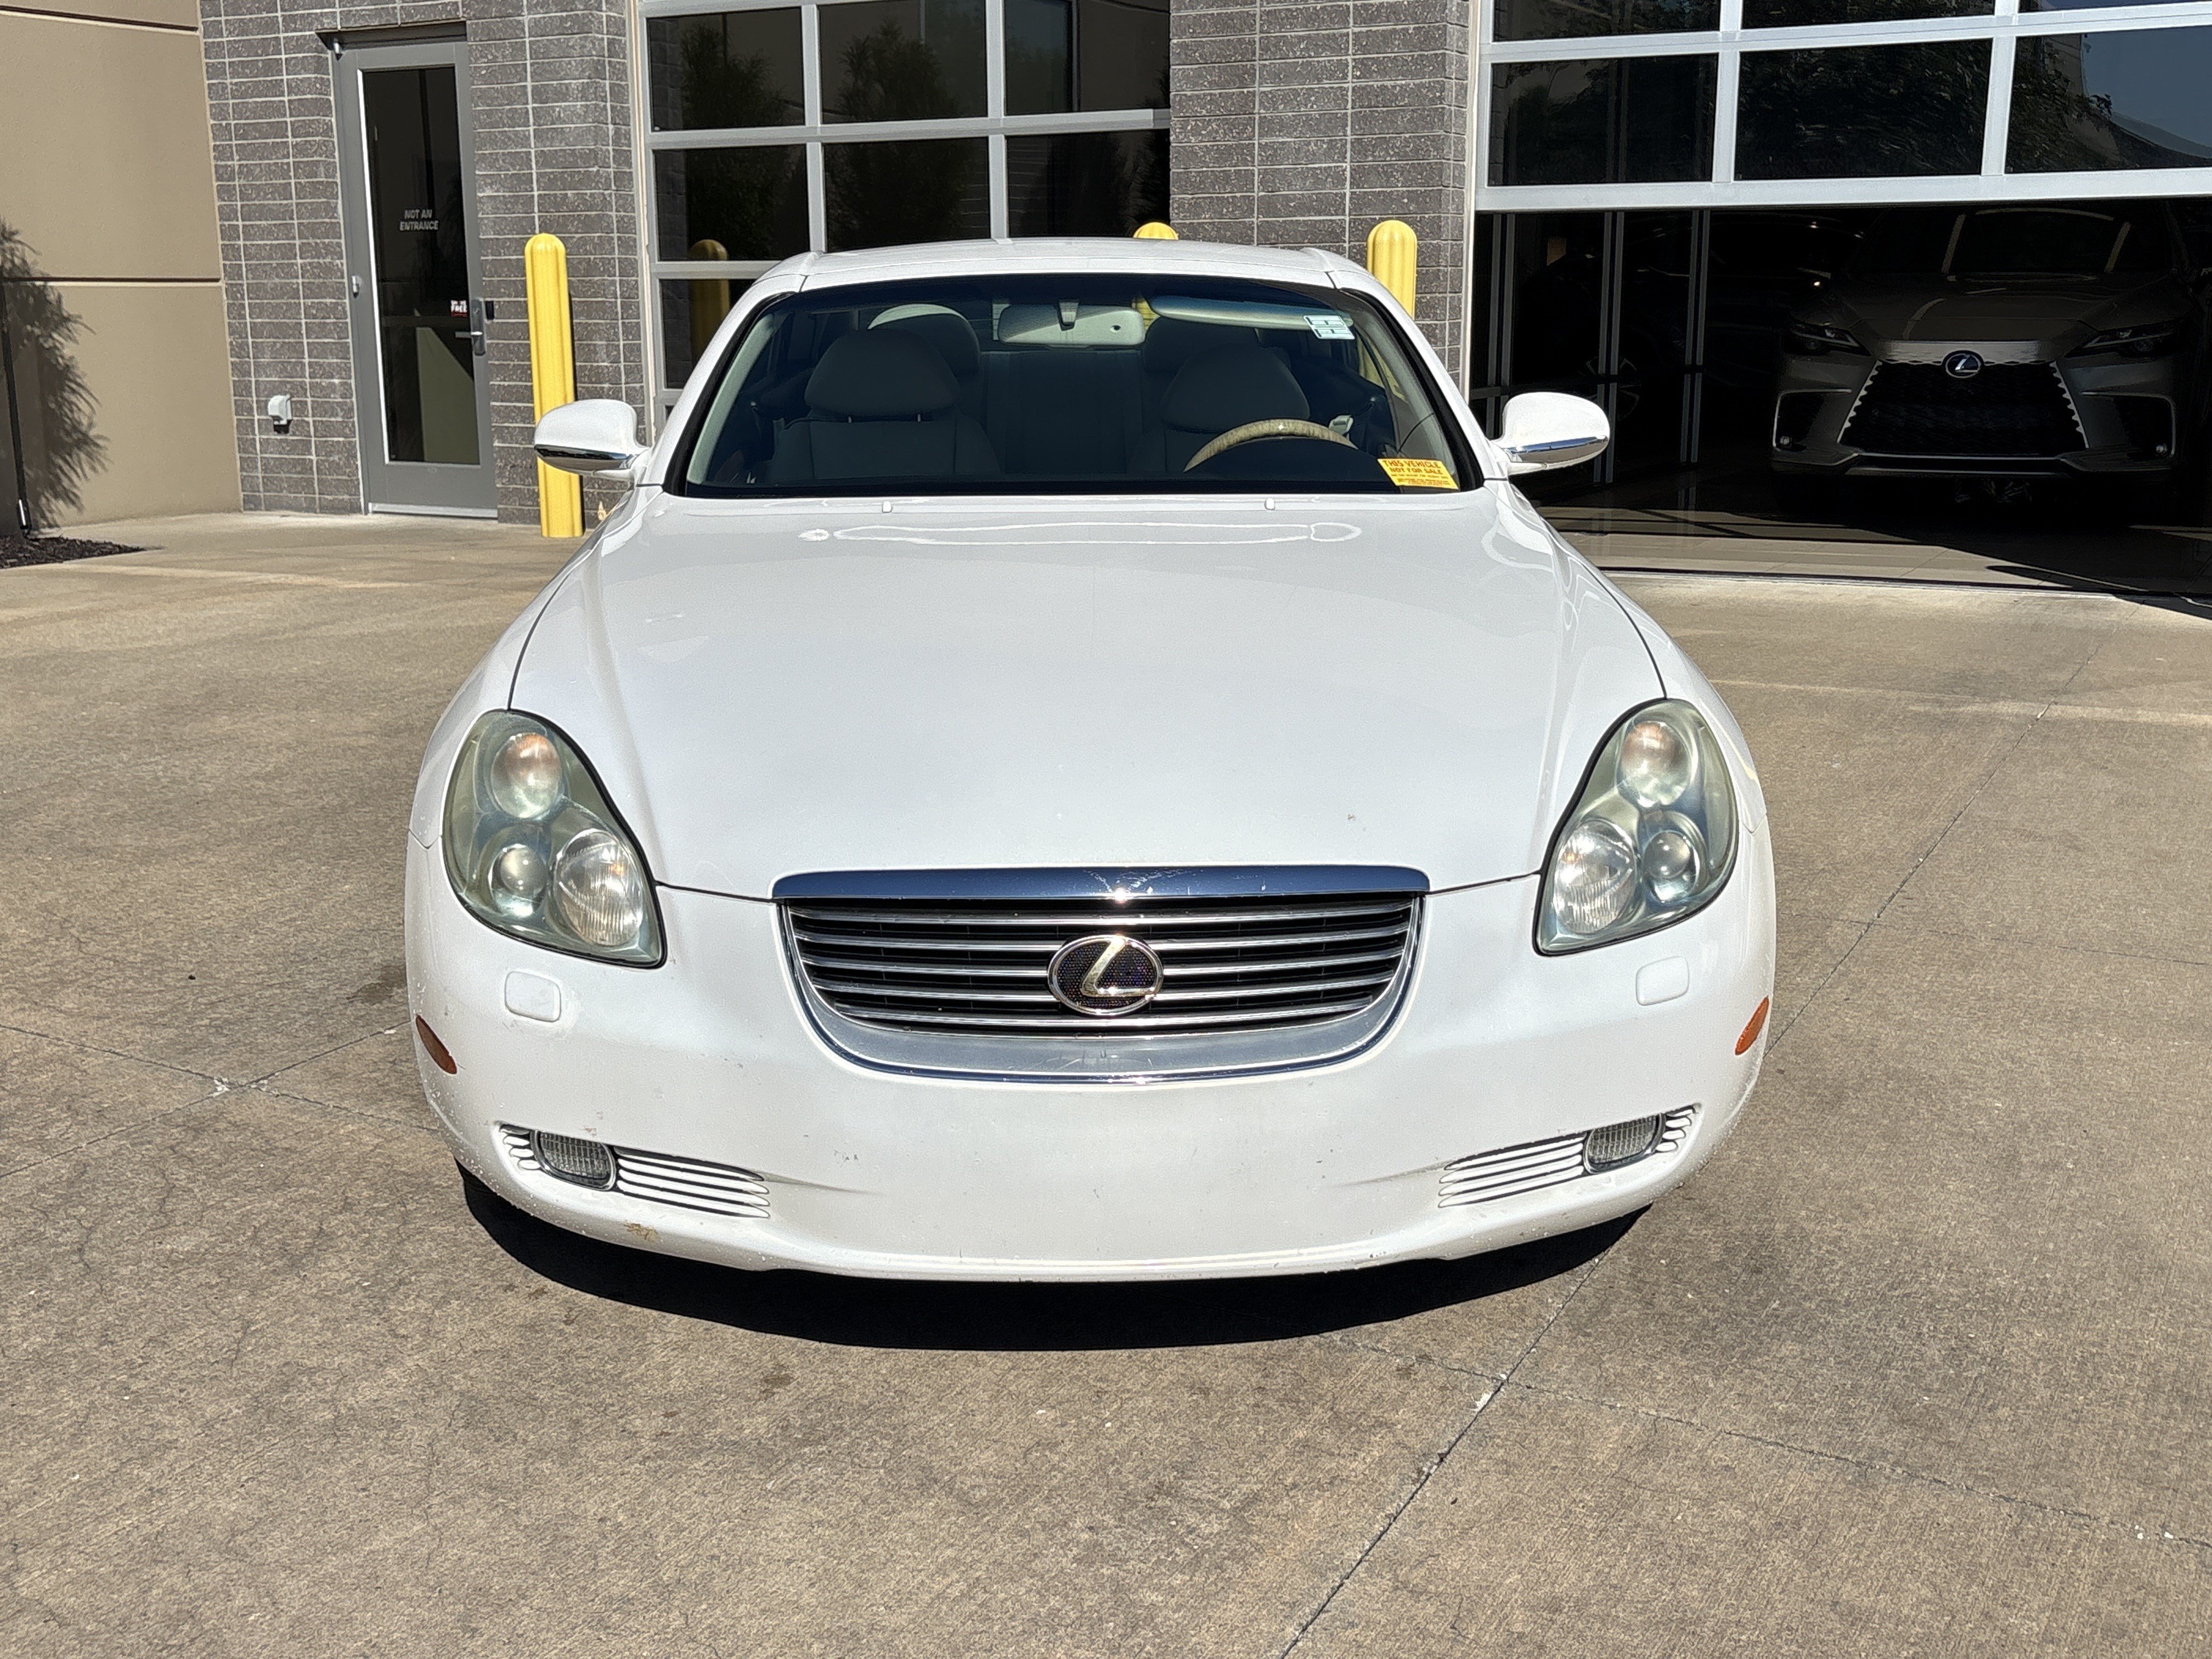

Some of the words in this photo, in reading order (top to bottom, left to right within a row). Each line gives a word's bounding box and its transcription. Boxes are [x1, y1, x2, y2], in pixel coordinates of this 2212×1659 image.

[404, 209, 420, 219] NOT
[421, 209, 432, 219] AN
[399, 220, 439, 231] ENTRANCE
